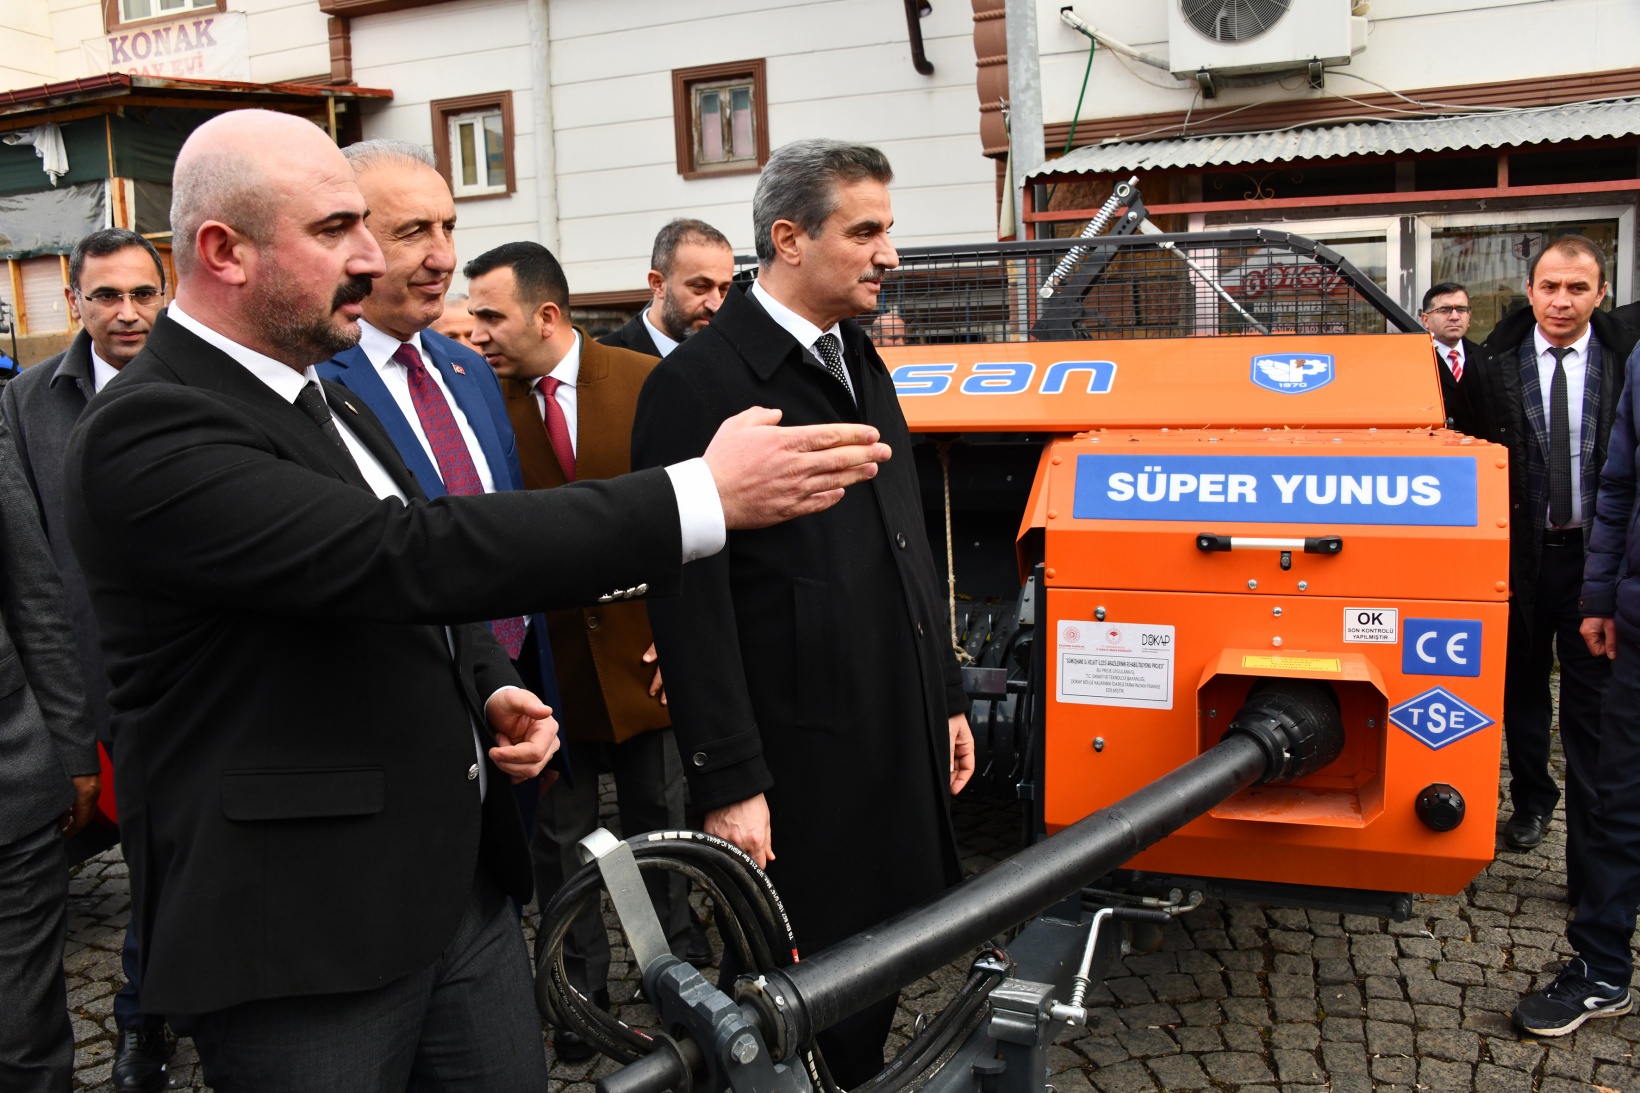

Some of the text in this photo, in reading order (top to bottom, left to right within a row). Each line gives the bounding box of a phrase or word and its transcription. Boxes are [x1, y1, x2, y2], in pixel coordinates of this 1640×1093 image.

[108, 19, 217, 65] KONAK
[1107, 466, 1442, 506] SÜPER YUNUS
[1357, 612, 1383, 625] OK
[1416, 631, 1468, 664] CE
[1408, 703, 1465, 733] TSE
